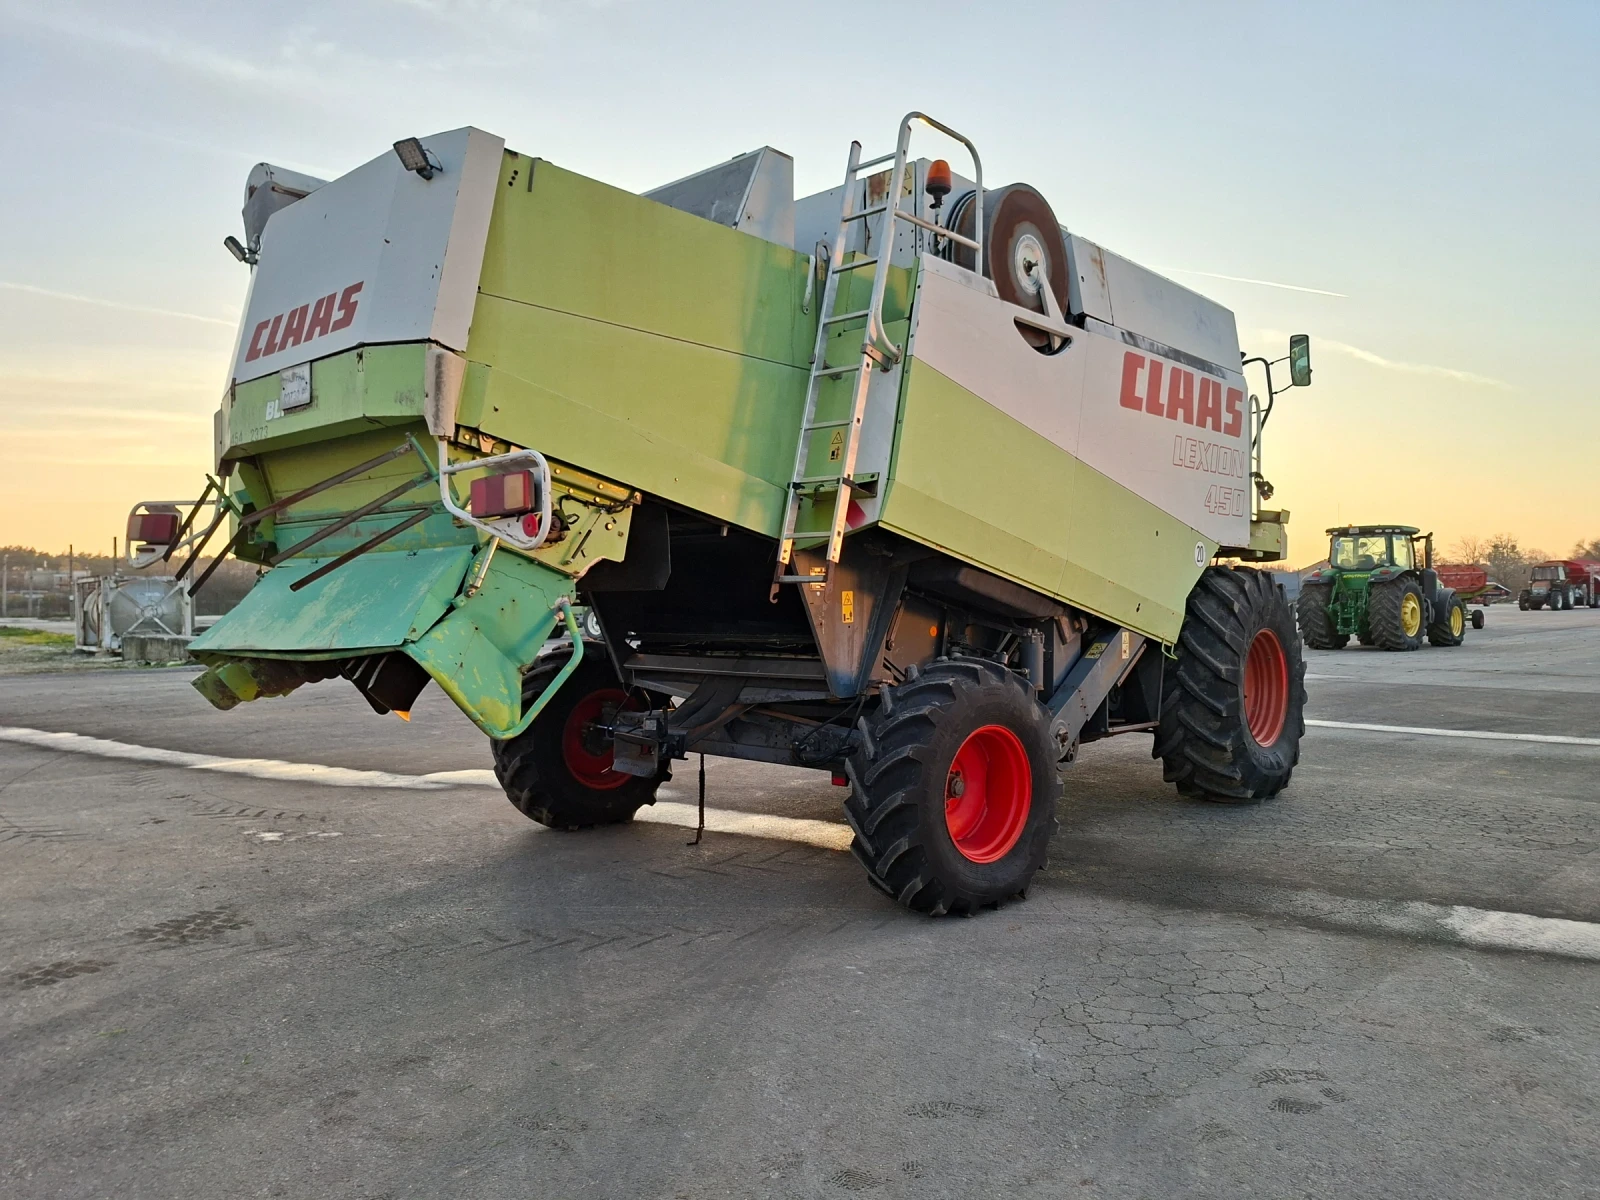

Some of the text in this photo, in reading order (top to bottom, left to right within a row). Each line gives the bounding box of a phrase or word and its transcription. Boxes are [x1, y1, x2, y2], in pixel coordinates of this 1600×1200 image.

[245, 281, 364, 363] CLAAS
[1119, 351, 1243, 438] CLAAS
[1172, 435, 1244, 478] LEXION
[1204, 485, 1245, 517] 450
[1196, 546, 1204, 563] 20
